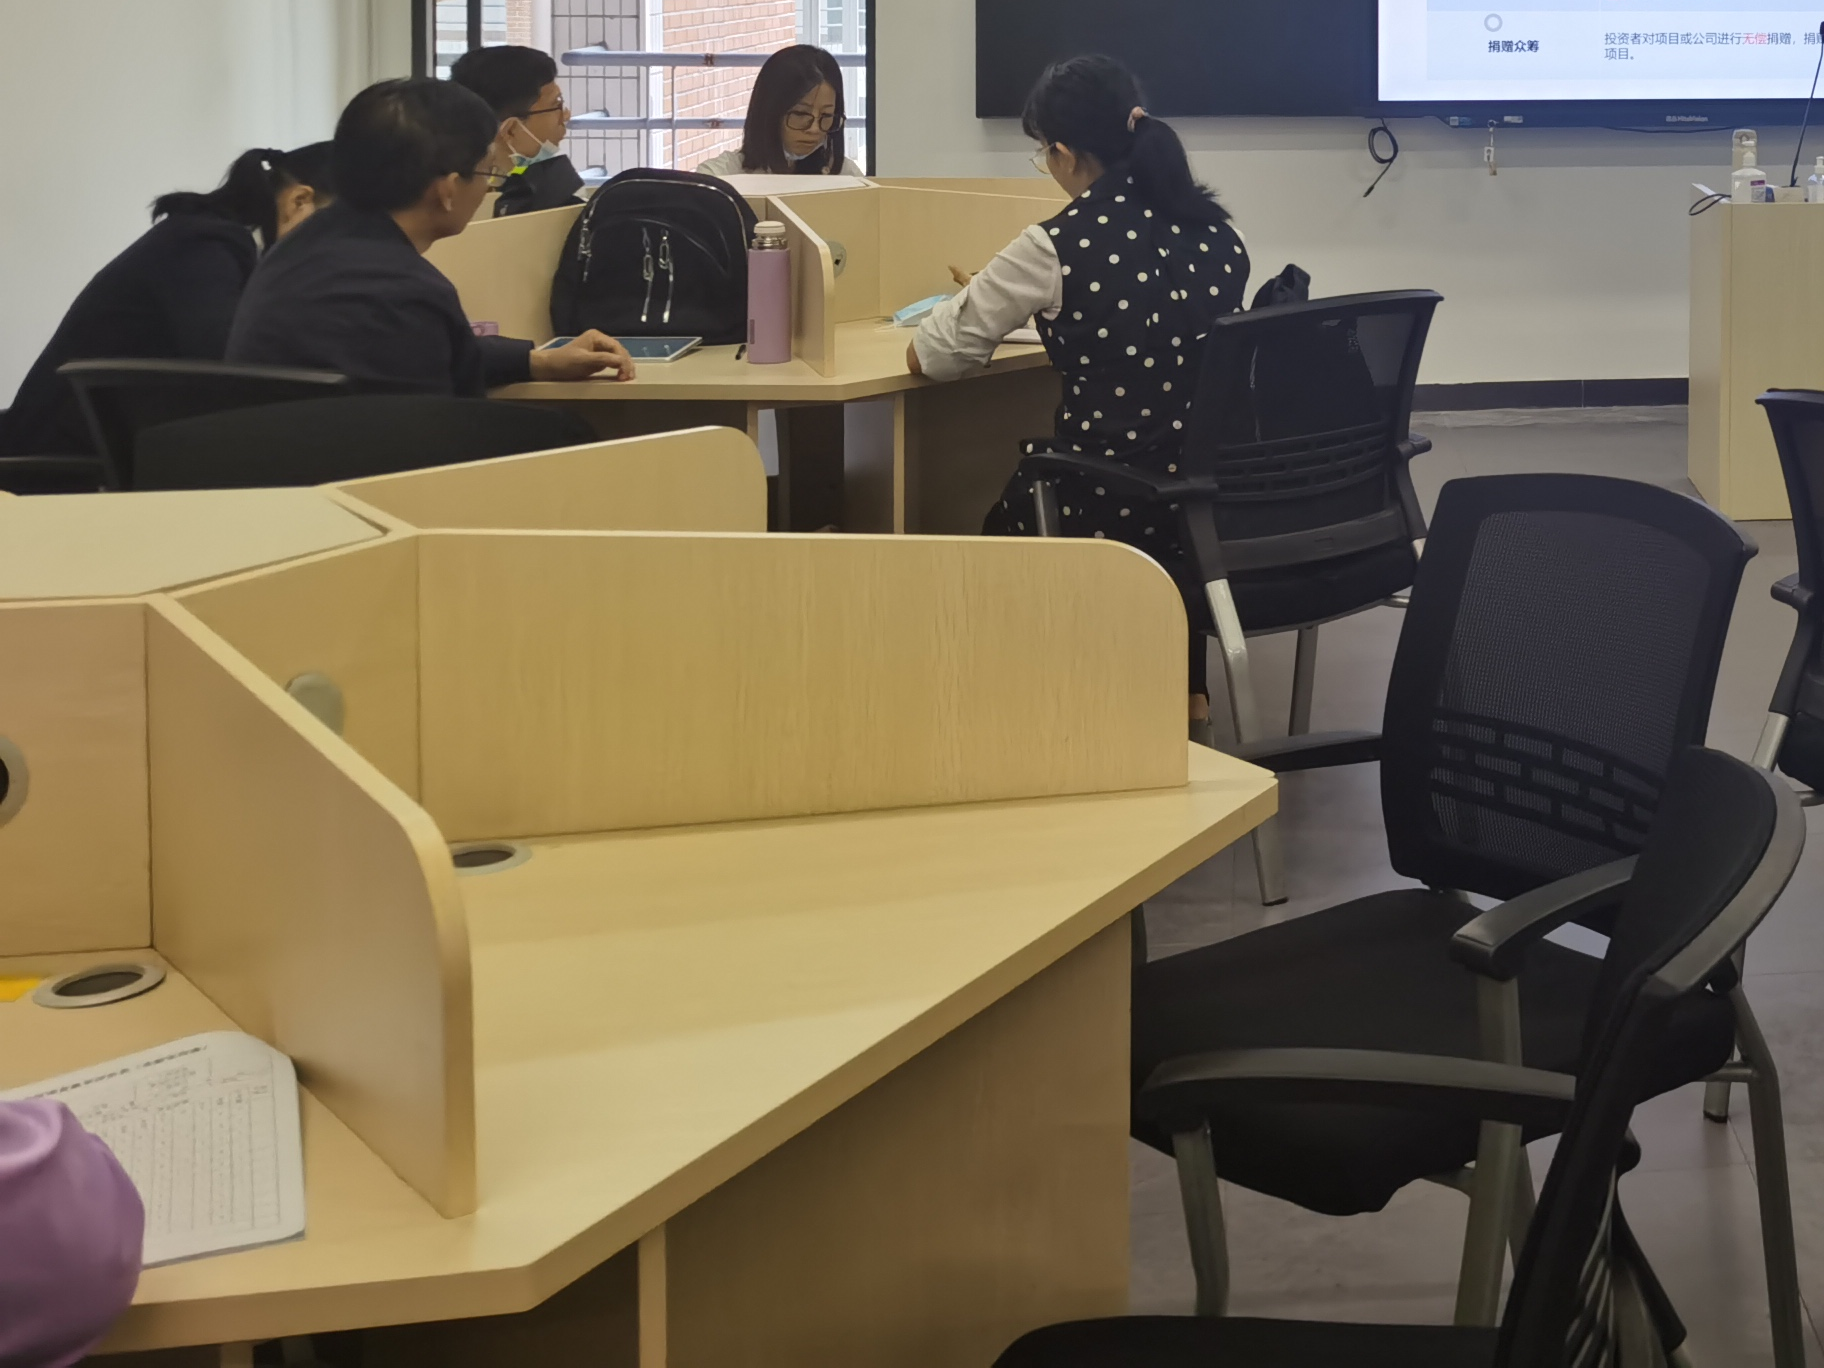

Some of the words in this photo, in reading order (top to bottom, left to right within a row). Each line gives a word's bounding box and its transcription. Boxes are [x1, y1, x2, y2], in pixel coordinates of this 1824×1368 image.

[1488, 39, 1540, 53] 捐赠众筹
[1604, 48, 1636, 61] 项目。
